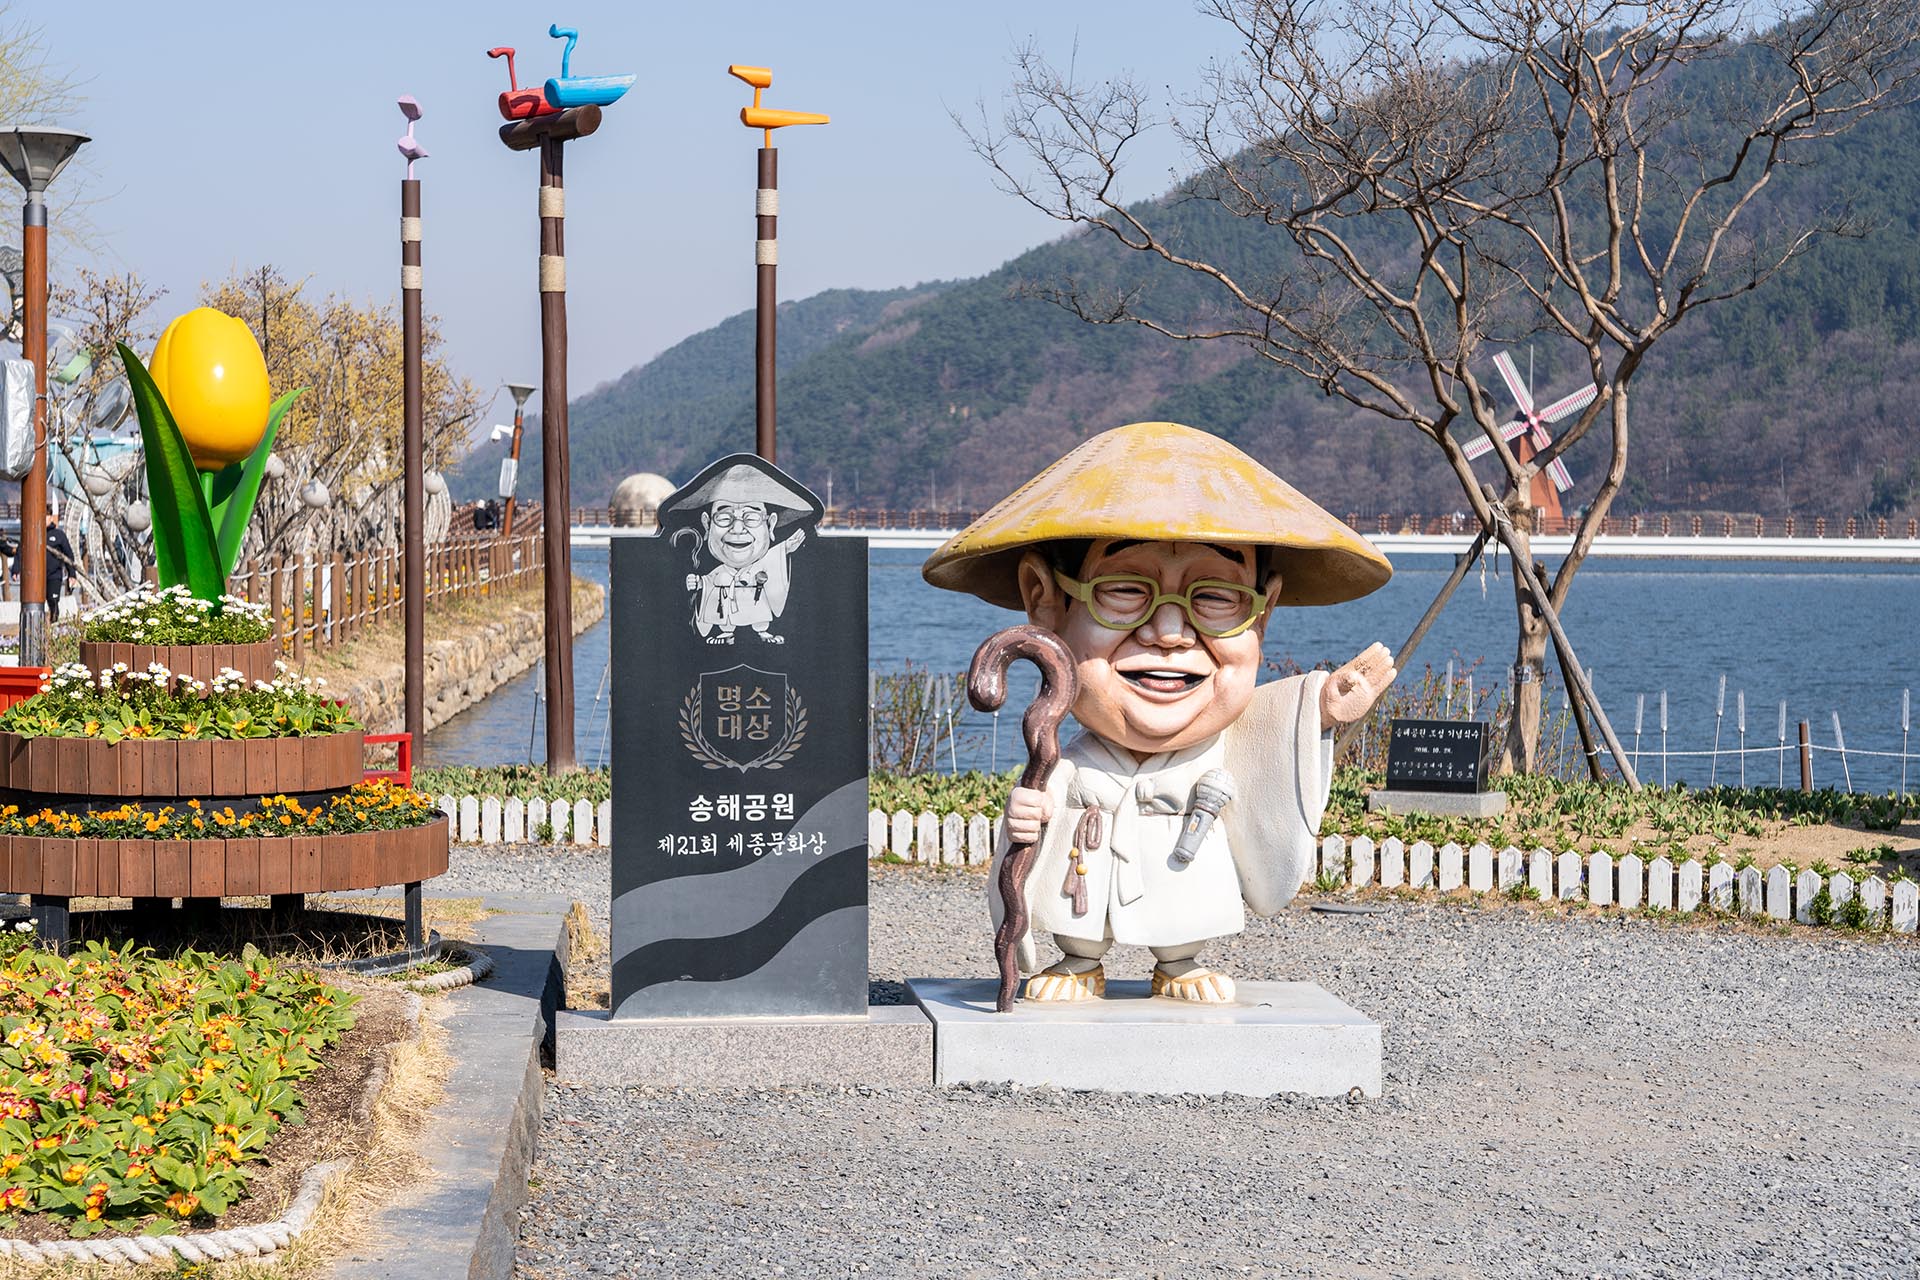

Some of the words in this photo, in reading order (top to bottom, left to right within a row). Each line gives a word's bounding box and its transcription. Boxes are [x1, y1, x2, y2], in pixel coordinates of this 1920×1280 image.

[717, 685, 772, 712] 명소
[716, 714, 773, 741] 대상
[688, 793, 794, 823] 송해공원
[657, 832, 717, 857] 제21회
[725, 832, 827, 857] 세종문화상
